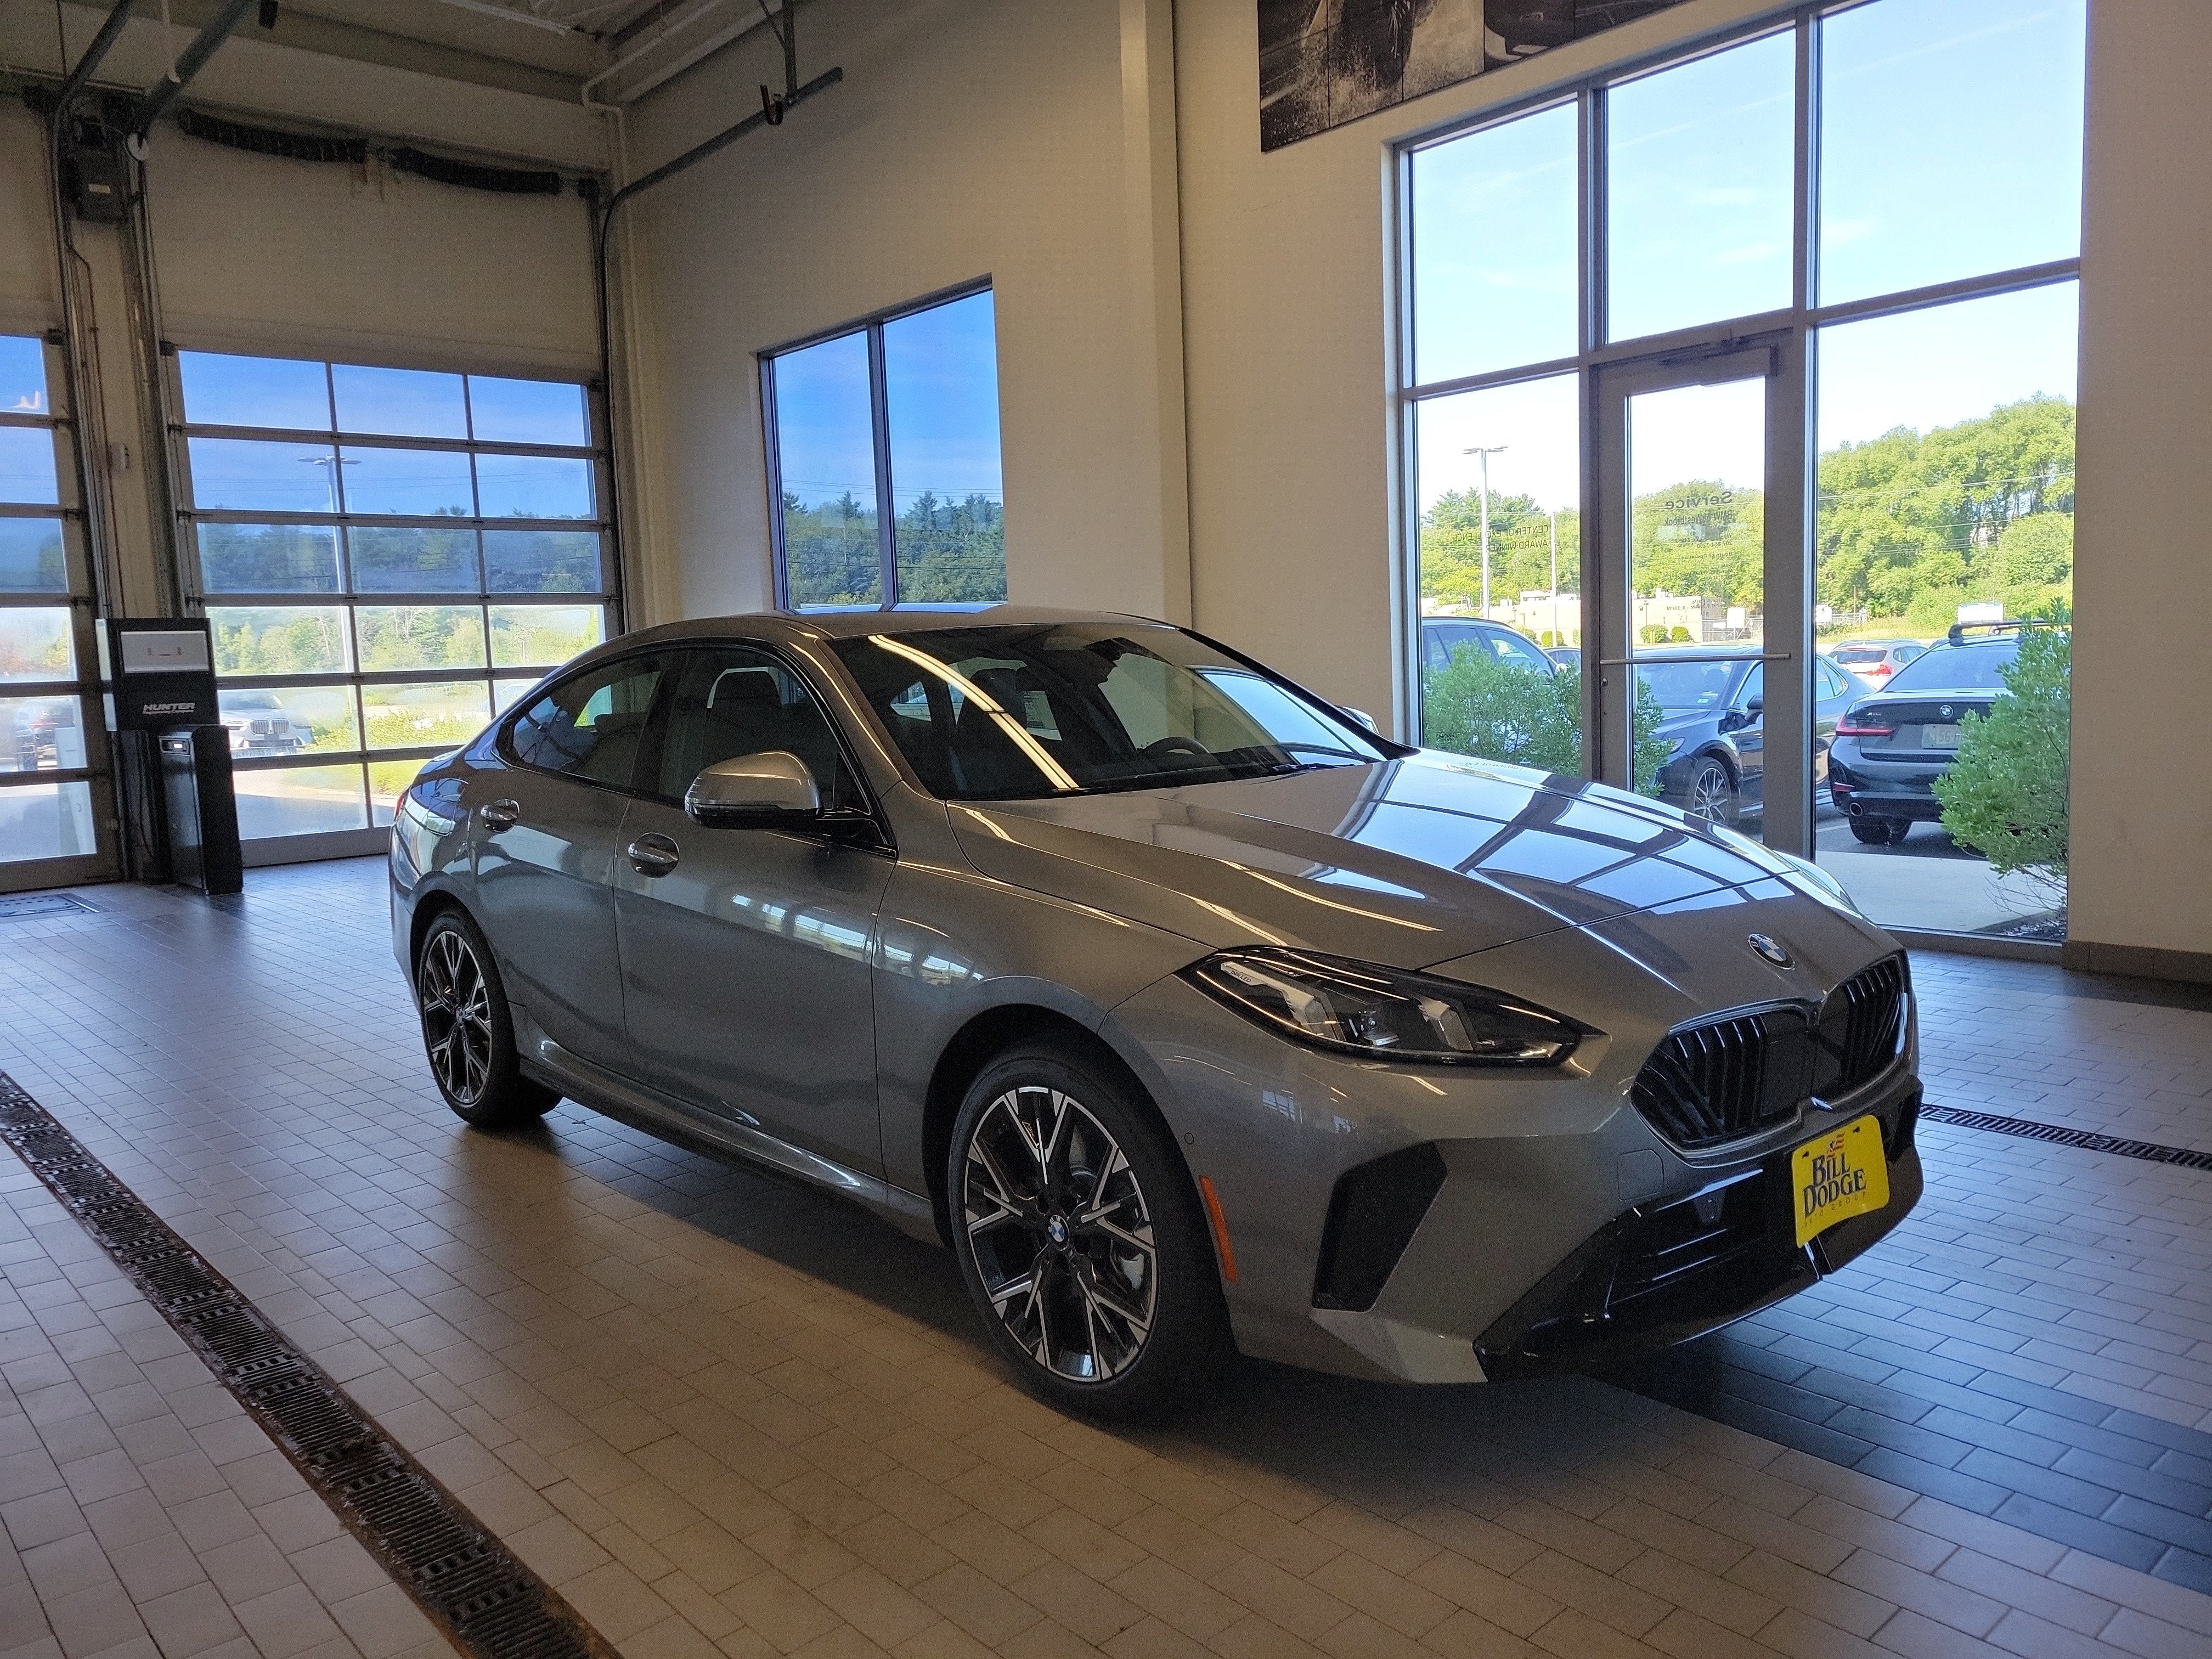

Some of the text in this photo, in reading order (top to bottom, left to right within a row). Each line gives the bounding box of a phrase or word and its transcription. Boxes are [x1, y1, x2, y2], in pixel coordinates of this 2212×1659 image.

[143, 702, 196, 711] HUNTER
[1803, 1169, 1867, 1219] DODGE
[1805, 1190, 1866, 1227] AUTO GROUP
